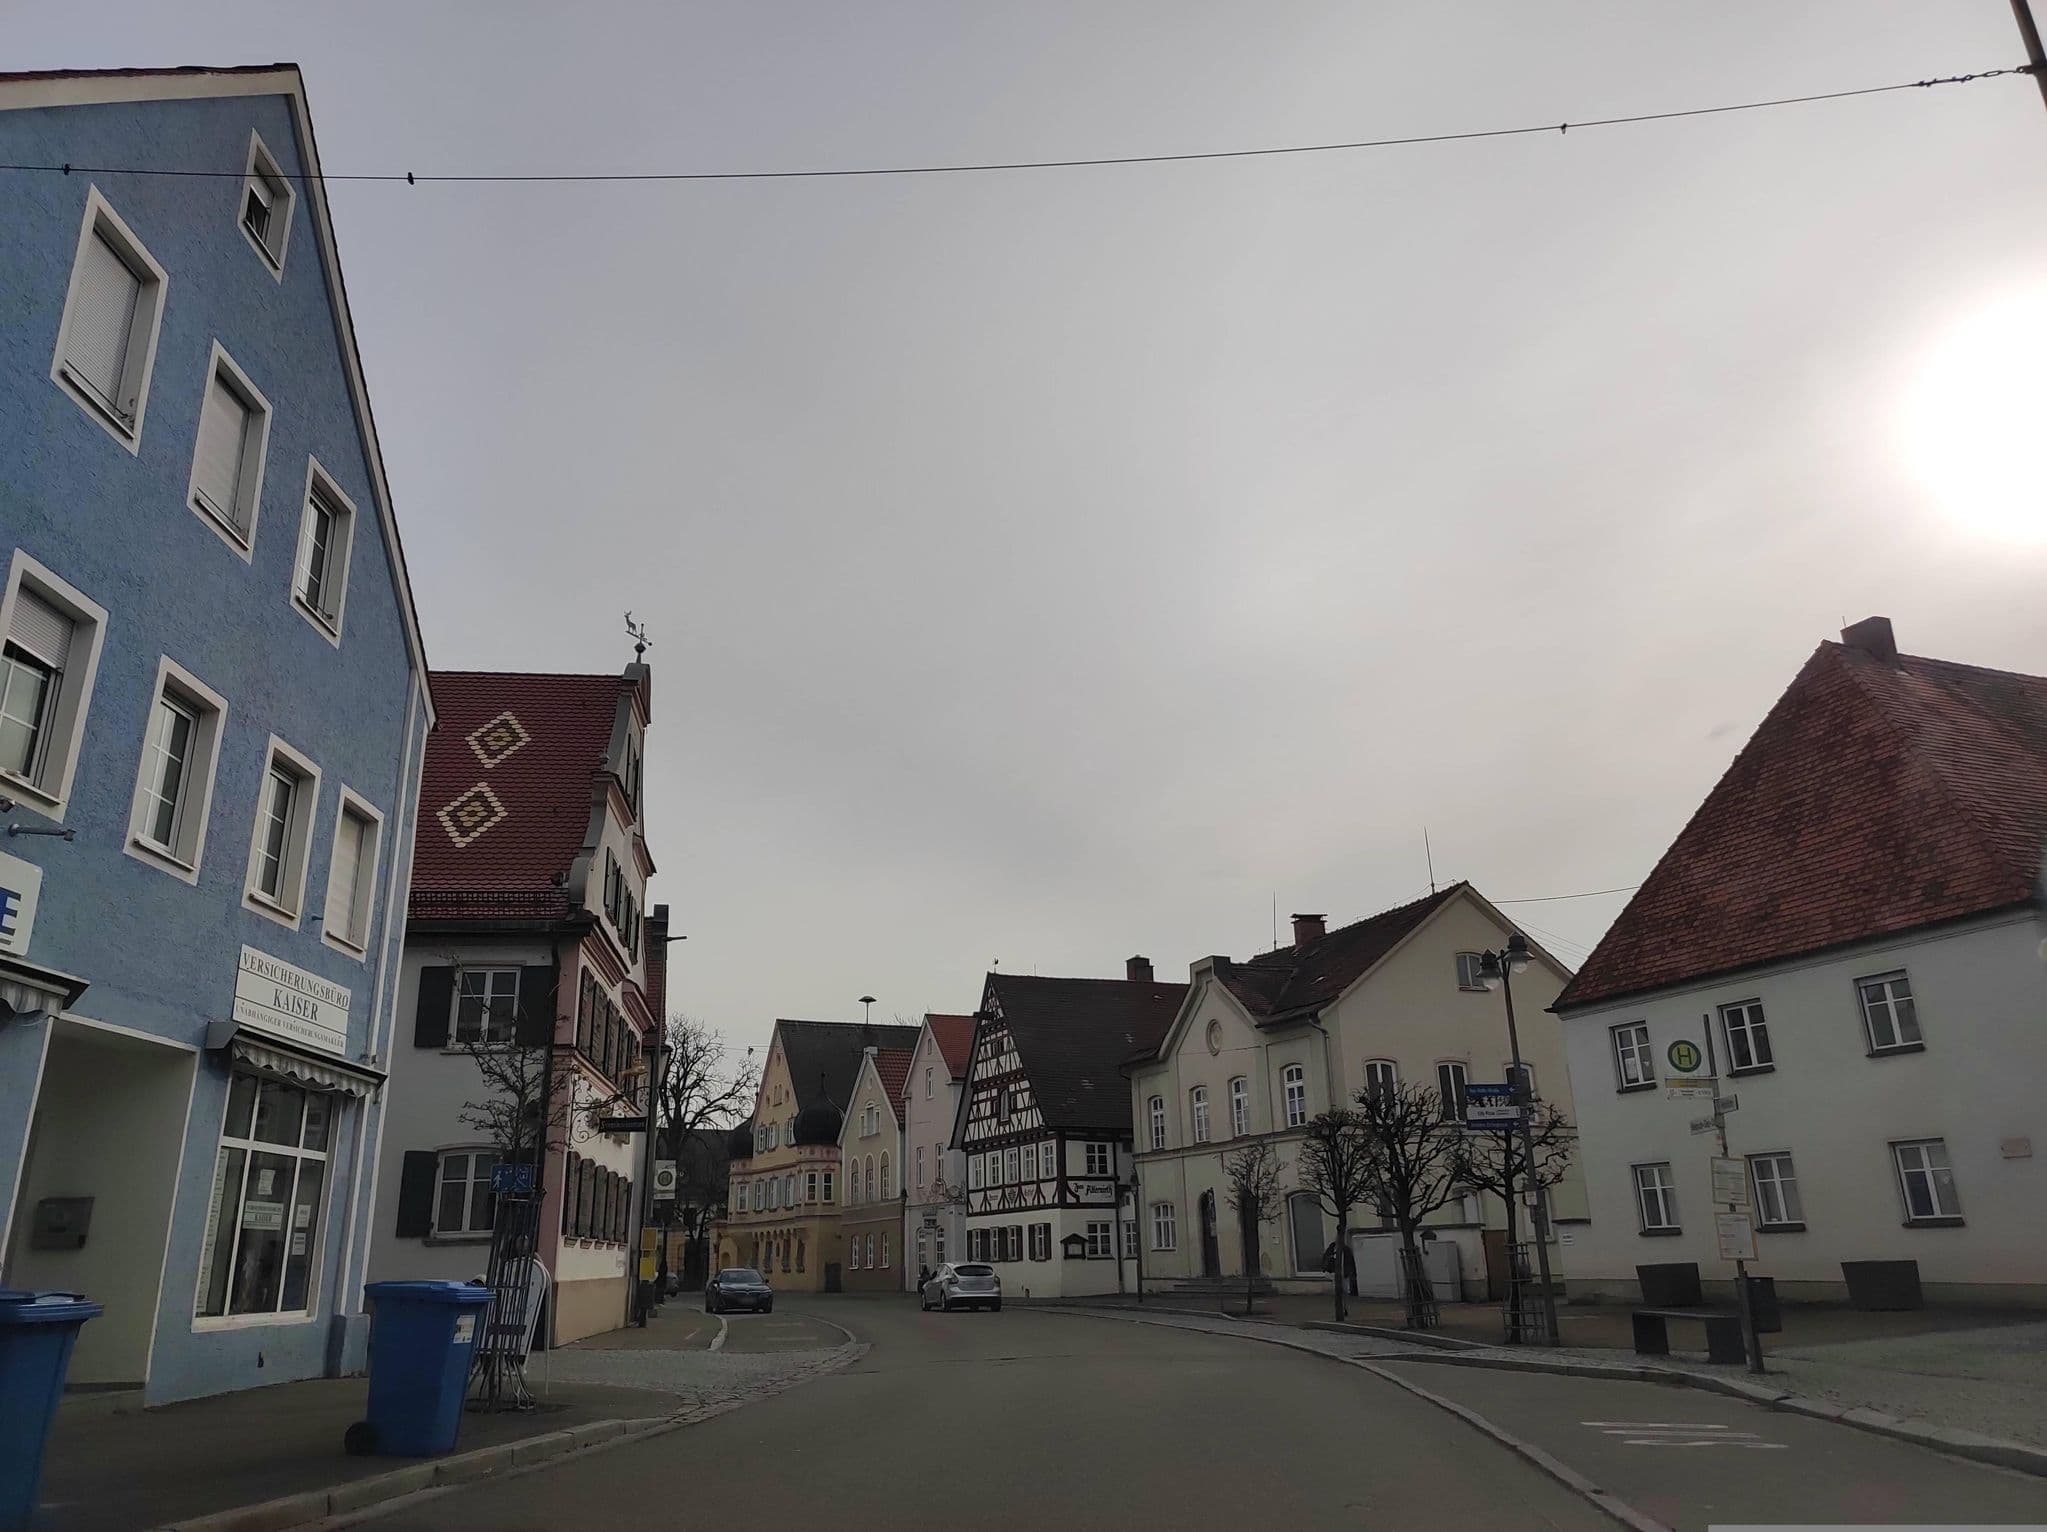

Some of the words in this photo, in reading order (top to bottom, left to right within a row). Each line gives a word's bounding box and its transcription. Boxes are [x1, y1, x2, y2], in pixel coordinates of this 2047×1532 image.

[243, 952, 348, 1008] VERSICHERUNGSBÜRO
[273, 988, 319, 1022] KAISER
[1676, 1047, 1692, 1065] H
